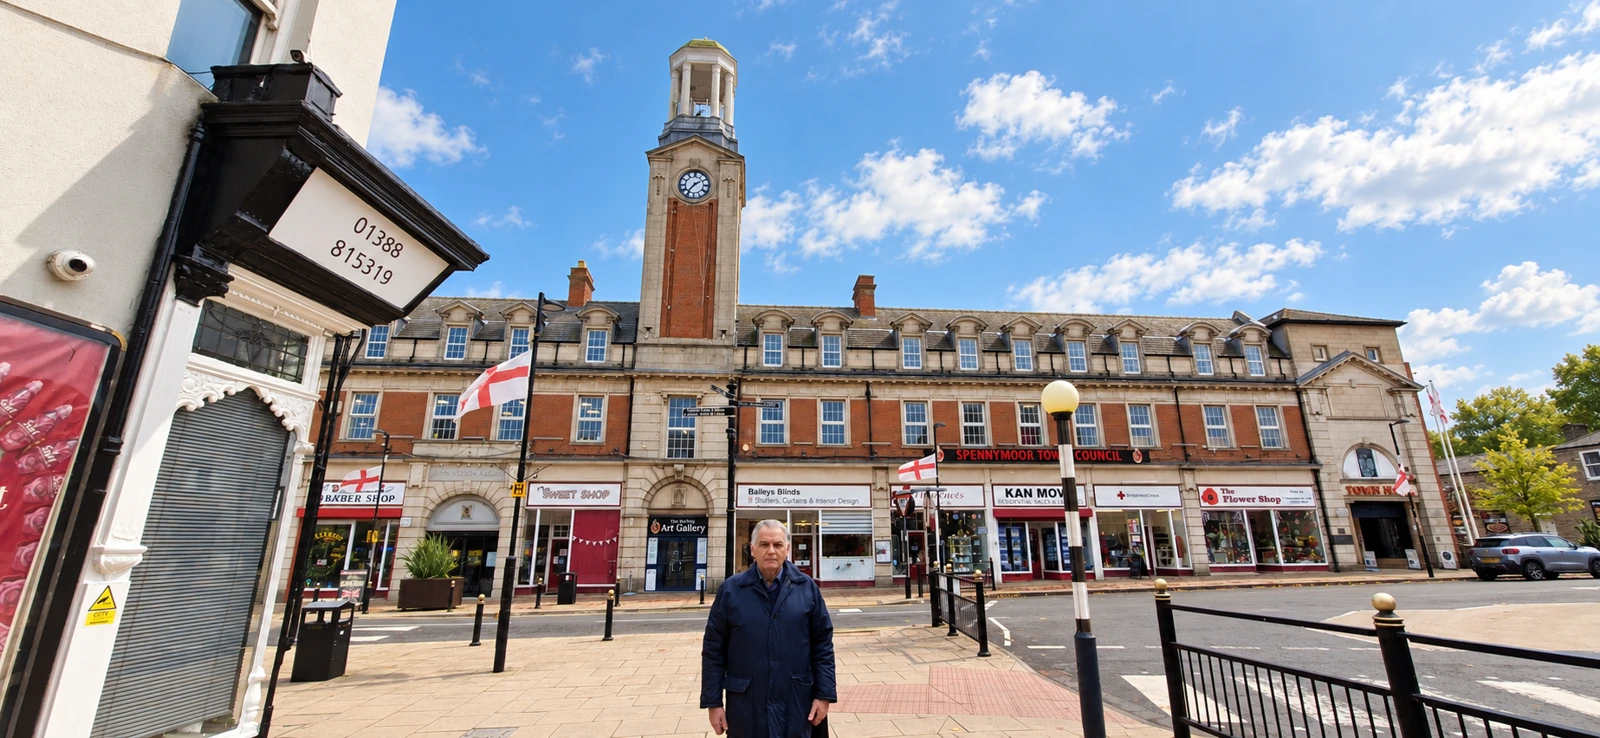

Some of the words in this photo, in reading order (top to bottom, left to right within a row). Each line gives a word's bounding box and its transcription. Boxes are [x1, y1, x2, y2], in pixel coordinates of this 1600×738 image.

[353, 217, 404, 259] 01388
[330, 239, 394, 285] 815319
[956, 449, 1034, 461] SPENNYMOOR
[1037, 450, 1060, 460] TOW
[1075, 450, 1122, 461] COUNCIL
[542, 487, 577, 499] SWEET
[581, 489, 610, 499] SHOP
[777, 488, 800, 496] Blinds
[1005, 488, 1033, 498] KAN
[1037, 488, 1065, 498] MOV
[1345, 485, 1381, 495] TOWN
[366, 494, 396, 503] SHOP
[838, 498, 860, 506] Design
[1258, 495, 1281, 505] Shop
[661, 524, 675, 532] Art
[676, 523, 706, 534] Gallery
